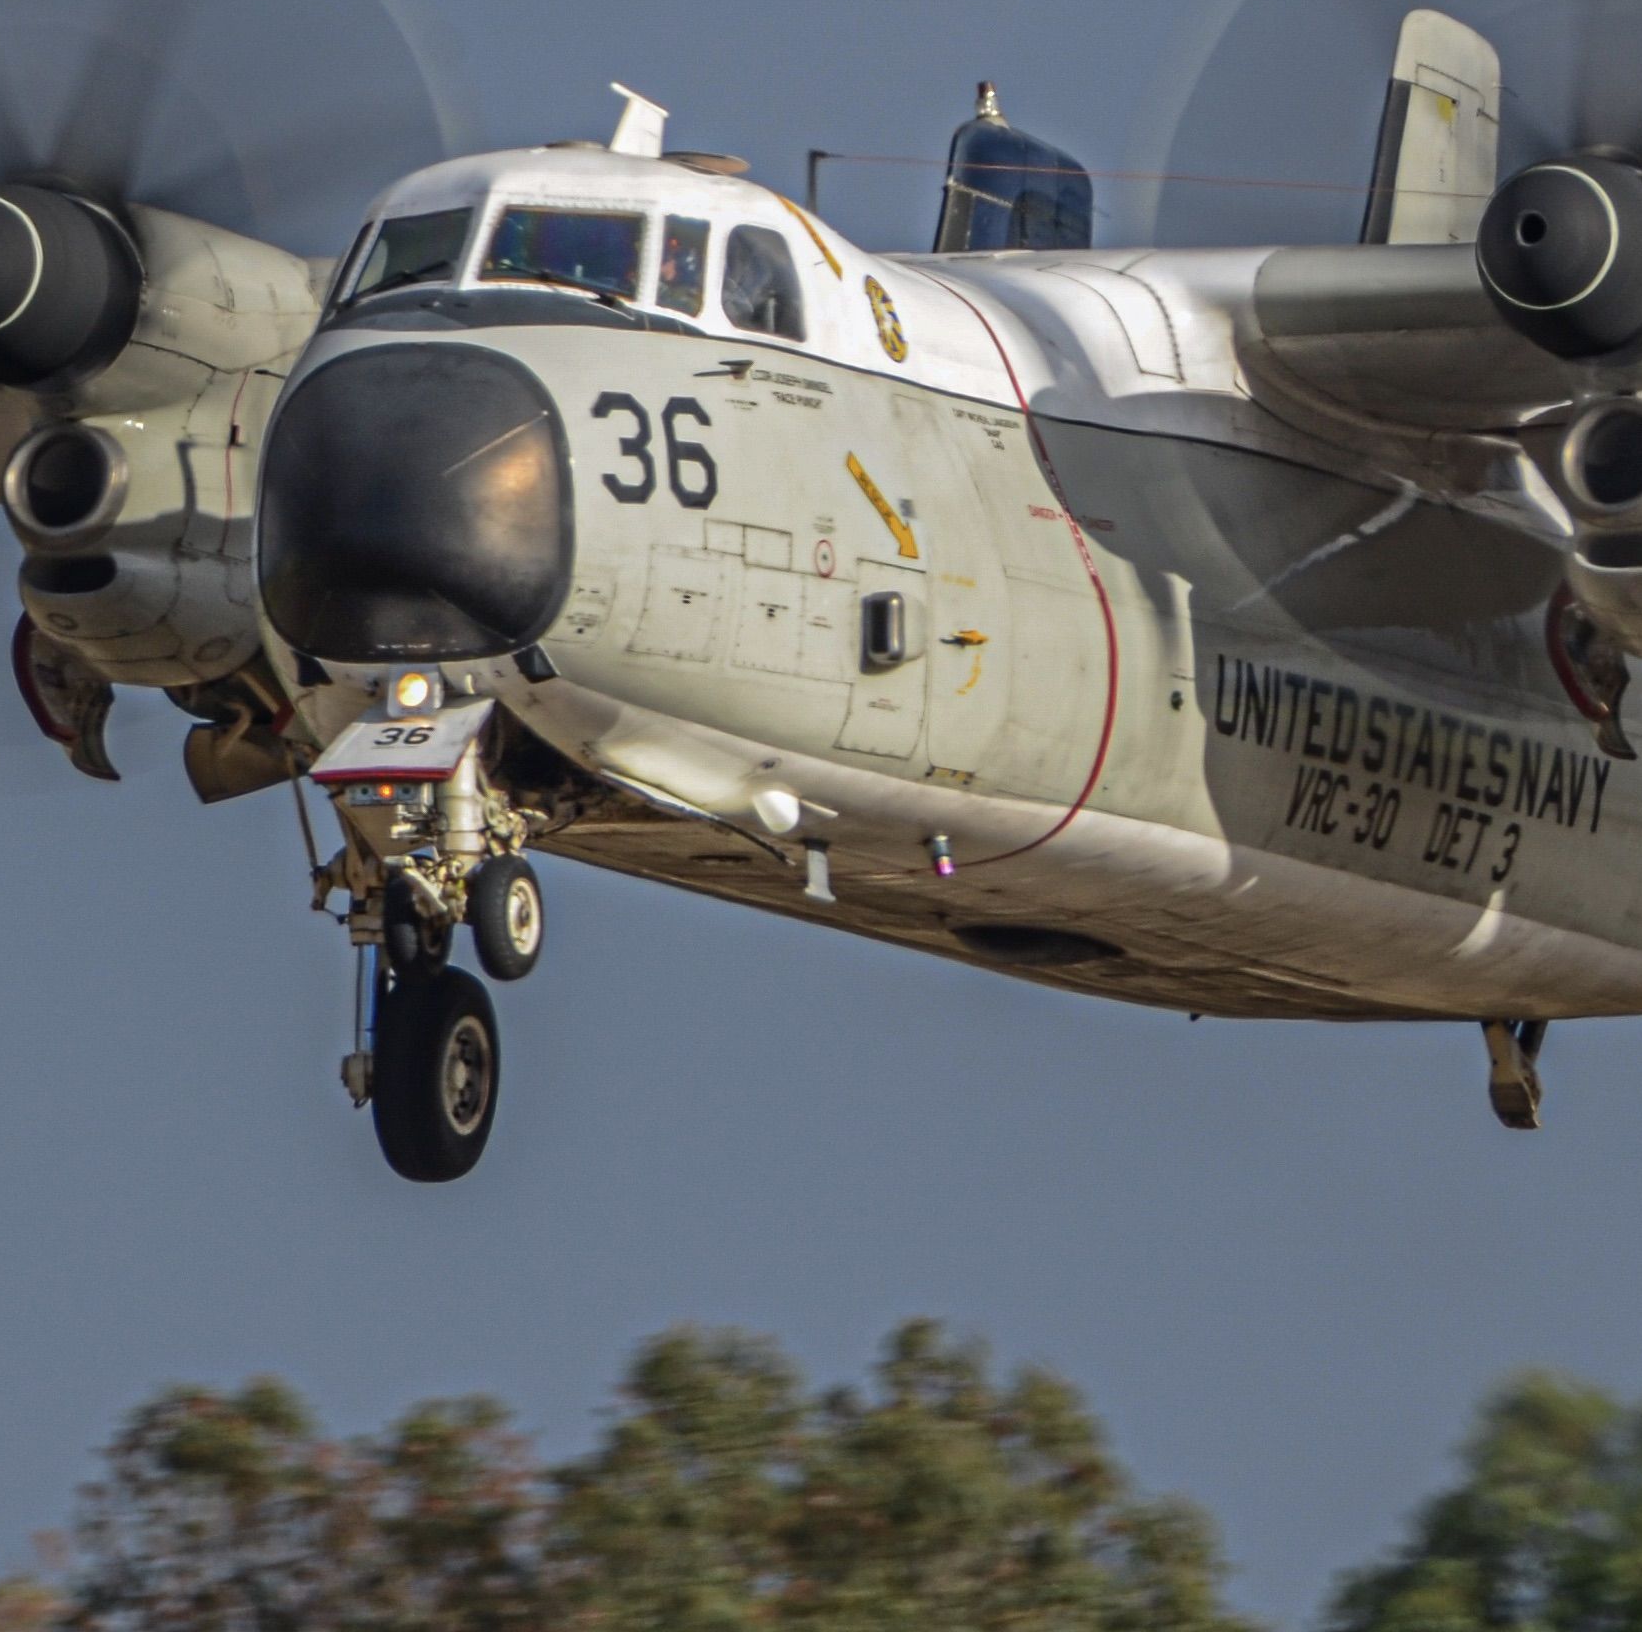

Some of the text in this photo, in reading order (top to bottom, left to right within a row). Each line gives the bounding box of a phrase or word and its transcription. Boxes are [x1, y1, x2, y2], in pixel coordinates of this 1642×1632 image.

[590, 391, 718, 510] 36
[374, 726, 435, 745] 36
[1214, 654, 1611, 834] UNITED STATES NAVY
[1285, 764, 1522, 883] VRC-30 DET 3
